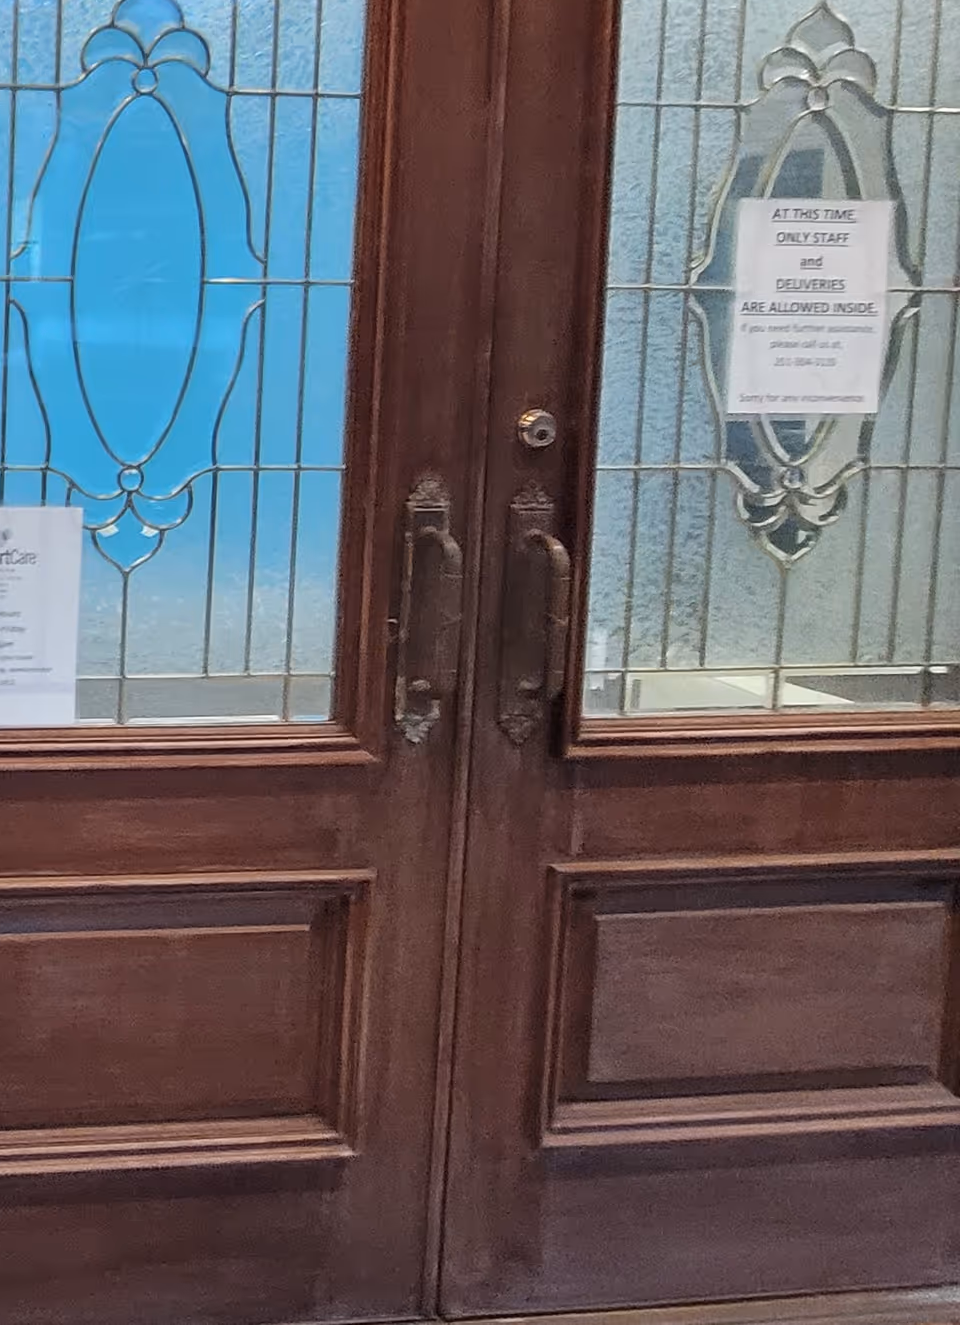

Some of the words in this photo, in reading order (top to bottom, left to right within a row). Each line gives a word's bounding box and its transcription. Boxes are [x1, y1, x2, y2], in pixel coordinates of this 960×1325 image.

[771, 208, 789, 221] AT
[792, 208, 820, 221] THIS
[776, 231, 810, 244] ONLY
[813, 232, 850, 245] STAFF
[800, 256, 823, 267] and
[776, 278, 846, 291] DELIVERIES
[741, 301, 766, 313] ARE
[769, 301, 830, 314] ALLOWED
[833, 302, 879, 315] INSIDE.
